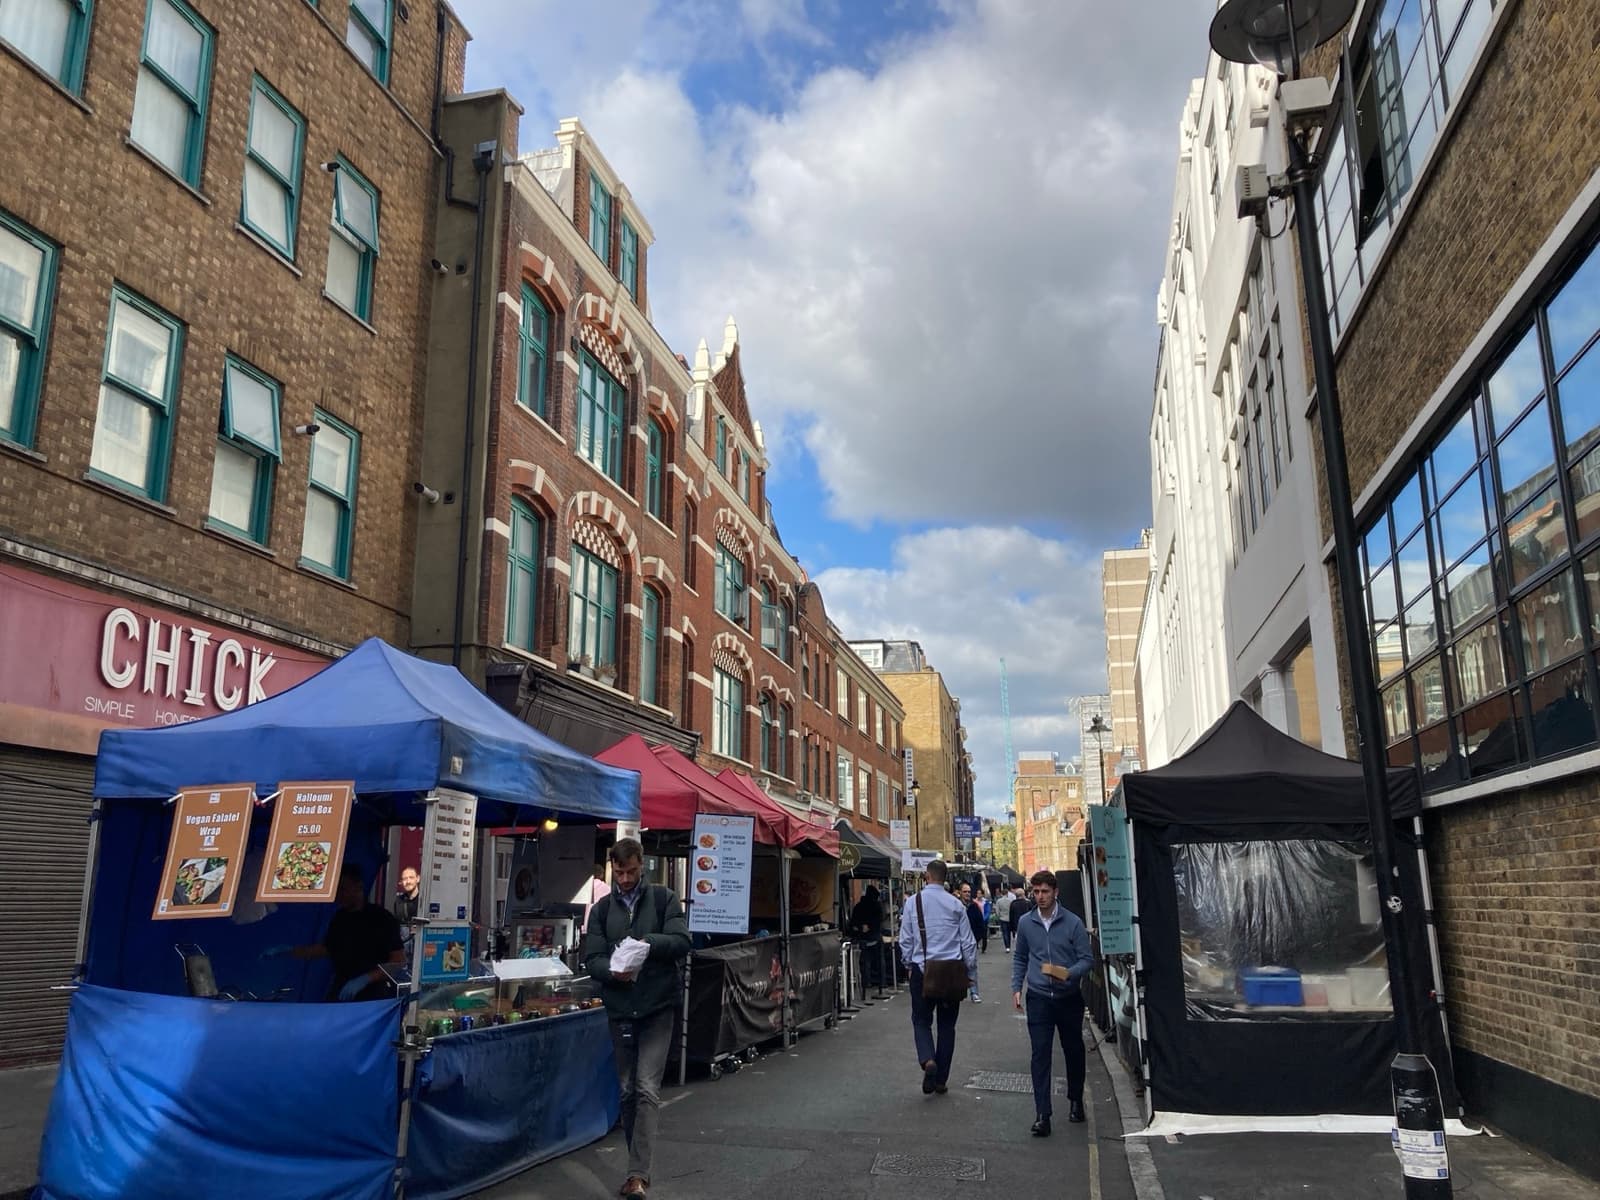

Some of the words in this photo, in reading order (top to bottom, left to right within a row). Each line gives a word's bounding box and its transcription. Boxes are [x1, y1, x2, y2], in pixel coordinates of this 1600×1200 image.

[101, 607, 278, 711] CHICK
[84, 696, 135, 719] SIMPLE
[295, 792, 333, 802] Halloumi
[292, 805, 316, 814] Salad
[316, 804, 333, 814] Box
[186, 813, 211, 825] Vegan
[211, 811, 240, 824] Falafel
[199, 826, 221, 837] Wrap
[297, 824, 321, 835] £5.00
